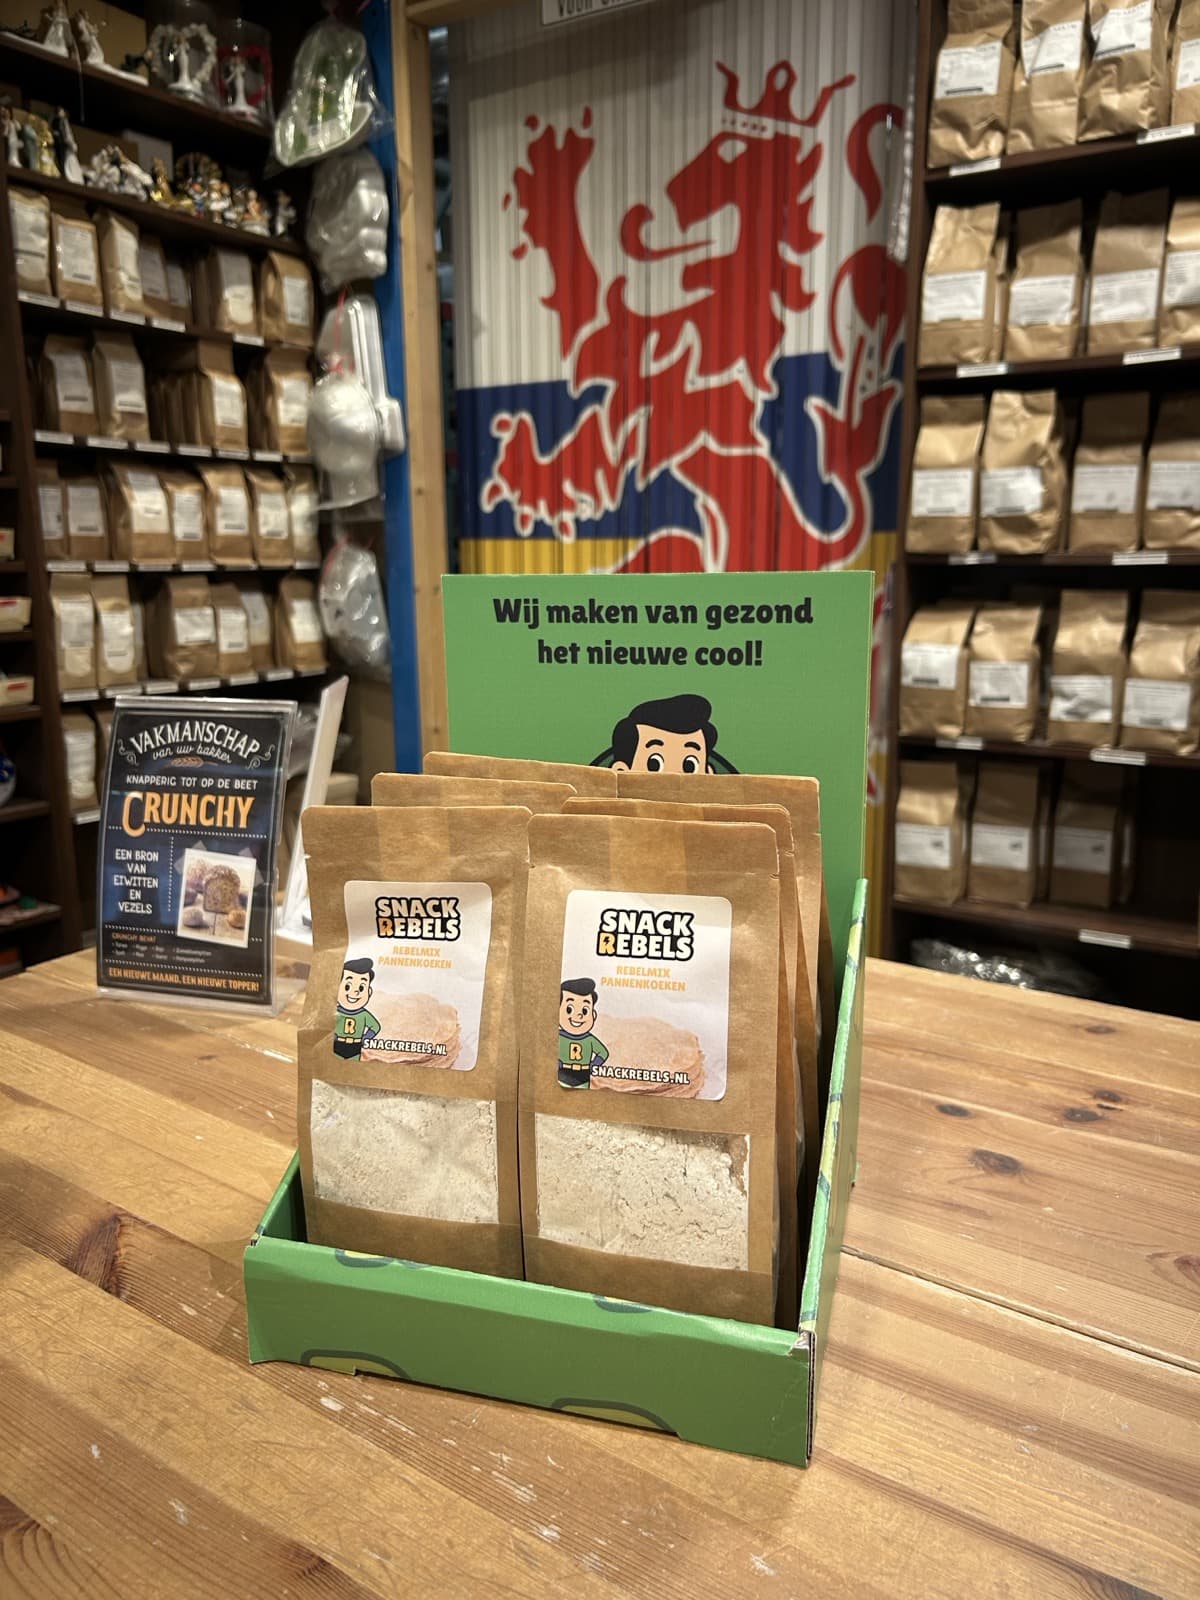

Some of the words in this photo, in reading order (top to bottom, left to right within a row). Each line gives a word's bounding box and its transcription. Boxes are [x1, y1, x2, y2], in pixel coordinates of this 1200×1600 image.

[493, 598, 540, 629] Wij
[546, 598, 638, 624] maken
[645, 604, 698, 624] van
[705, 597, 814, 630] gezond
[537, 639, 580, 665] het
[586, 640, 688, 666] nieuwe
[694, 640, 763, 667] cool!
[130, 720, 260, 760] VAKMANSCHAP
[152, 747, 174, 761] van
[196, 743, 232, 764] bakker
[126, 774, 177, 787] KNAPPERIG
[181, 776, 198, 788] TOT
[201, 778, 214, 788] OP
[217, 779, 230, 789] DE
[233, 779, 259, 790] BEET
[122, 790, 256, 837] CRUNCHY
[115, 848, 132, 860] EEN
[135, 850, 159, 862] BRON
[127, 863, 147, 874] VAN
[113, 874, 159, 889] EIWITTEN
[129, 889, 141, 900] EN
[118, 901, 153, 915] VEZELS
[375, 896, 460, 919] SNACK
[376, 916, 461, 941] REBELS
[601, 909, 694, 937] SNACK
[392, 945, 441, 957] REBELMIX
[597, 932, 694, 961] REBELS
[378, 957, 452, 969] PANNENKOEKEN
[616, 965, 671, 978] REBELMIX
[109, 967, 122, 978] EEN
[122, 969, 151, 981] NIEUWE
[182, 975, 197, 986] EEN
[197, 977, 228, 989] NIEUWE
[228, 979, 260, 993] TOPPER!
[601, 976, 686, 991] PANNENKOEKEN
[362, 1038, 448, 1056] SNACKREBELS.NL
[591, 1064, 690, 1085] SNACKREBELS.NL
